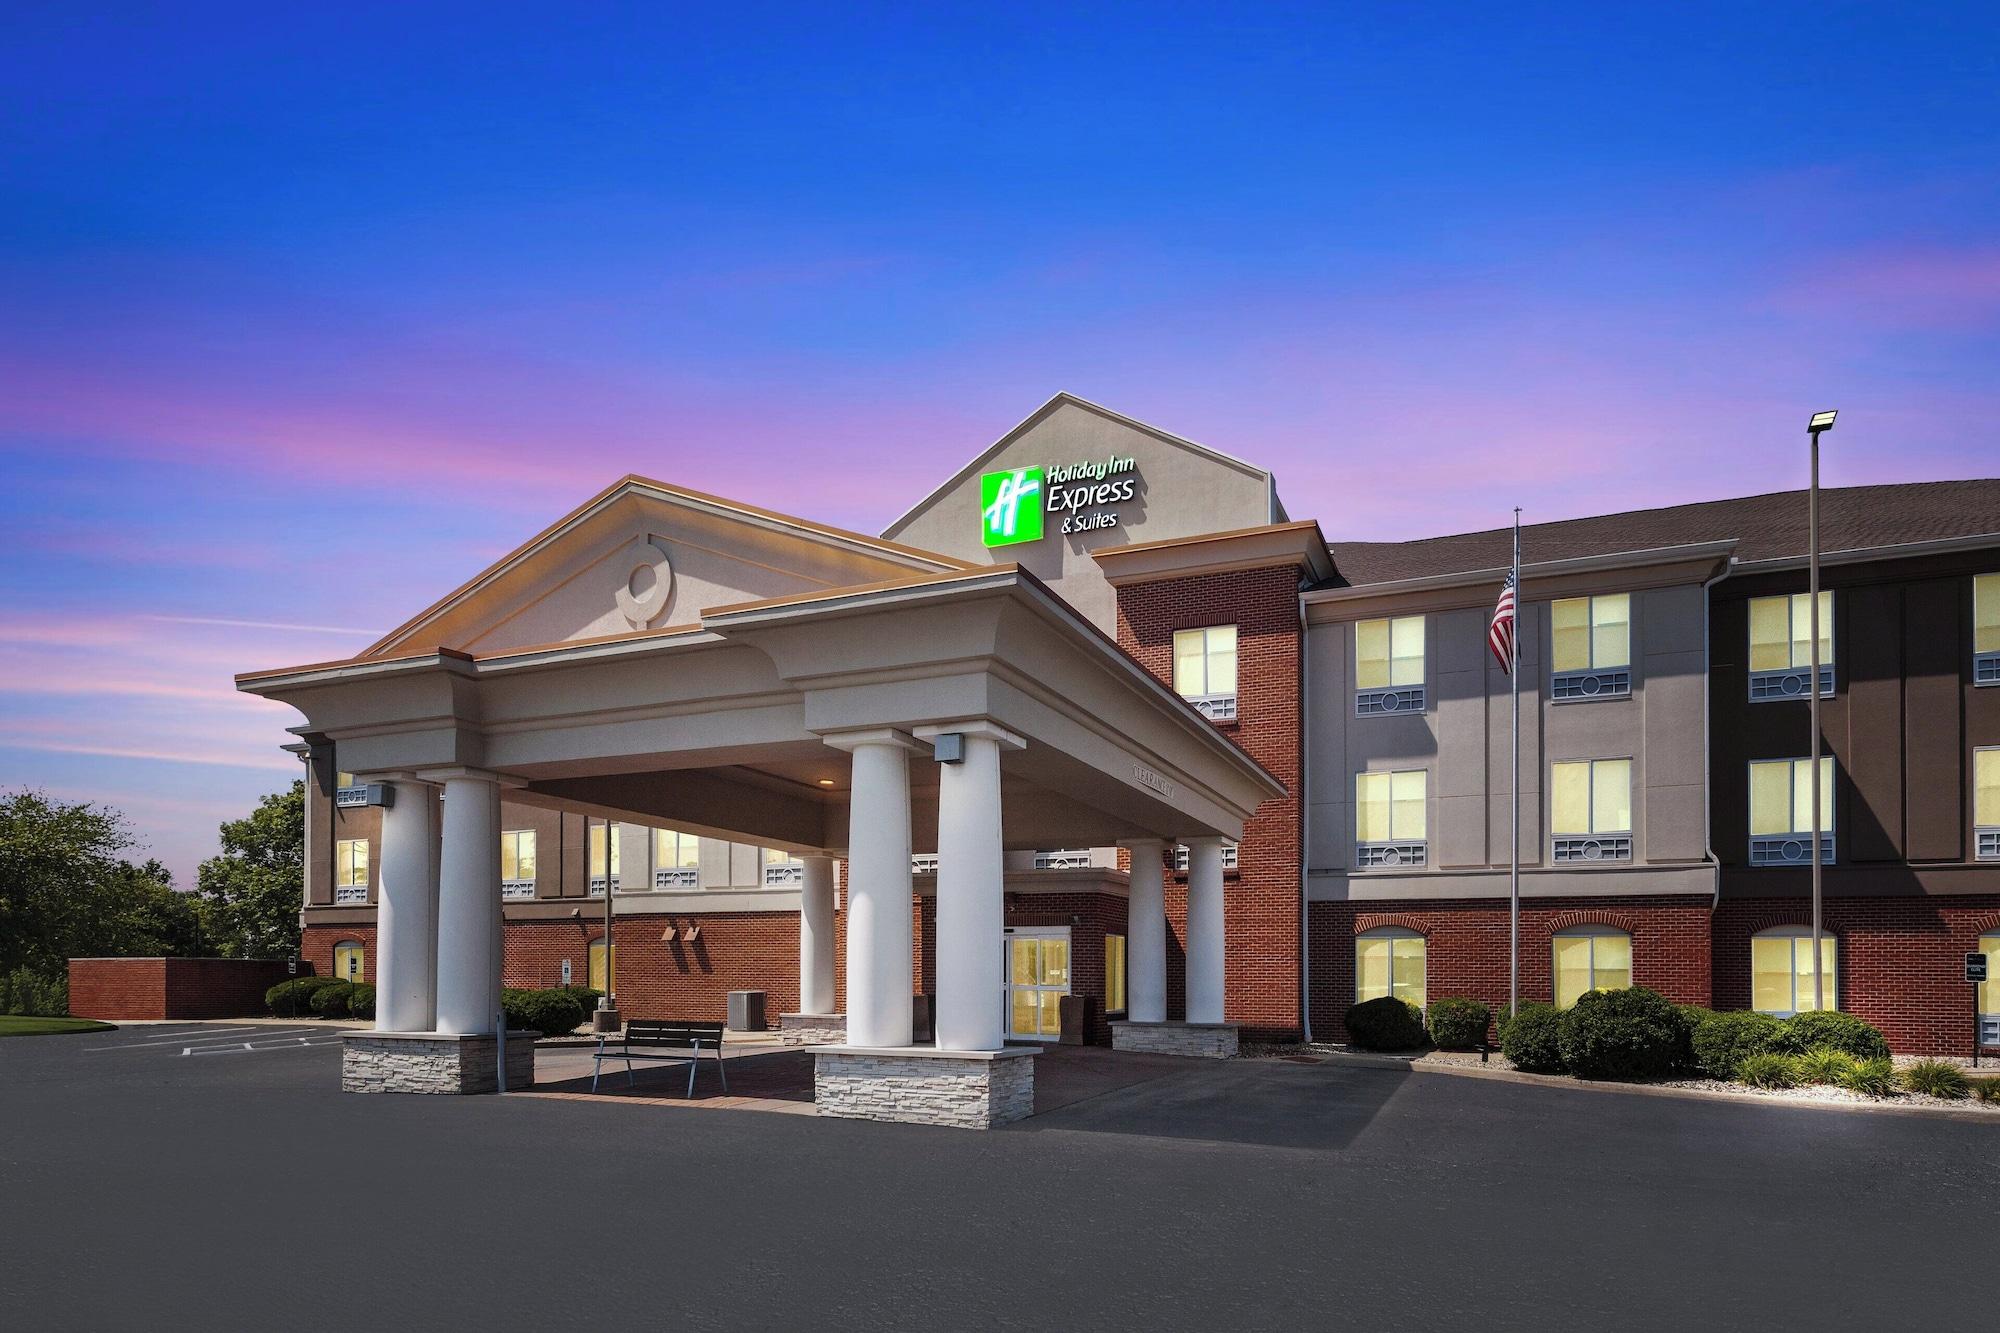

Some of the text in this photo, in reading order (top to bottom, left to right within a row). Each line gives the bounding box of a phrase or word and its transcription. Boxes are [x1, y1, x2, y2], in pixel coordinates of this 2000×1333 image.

[1046, 455, 1135, 484] Holiday Inn
[1046, 479, 1135, 515] Express
[1060, 513, 1117, 534] & Suites
